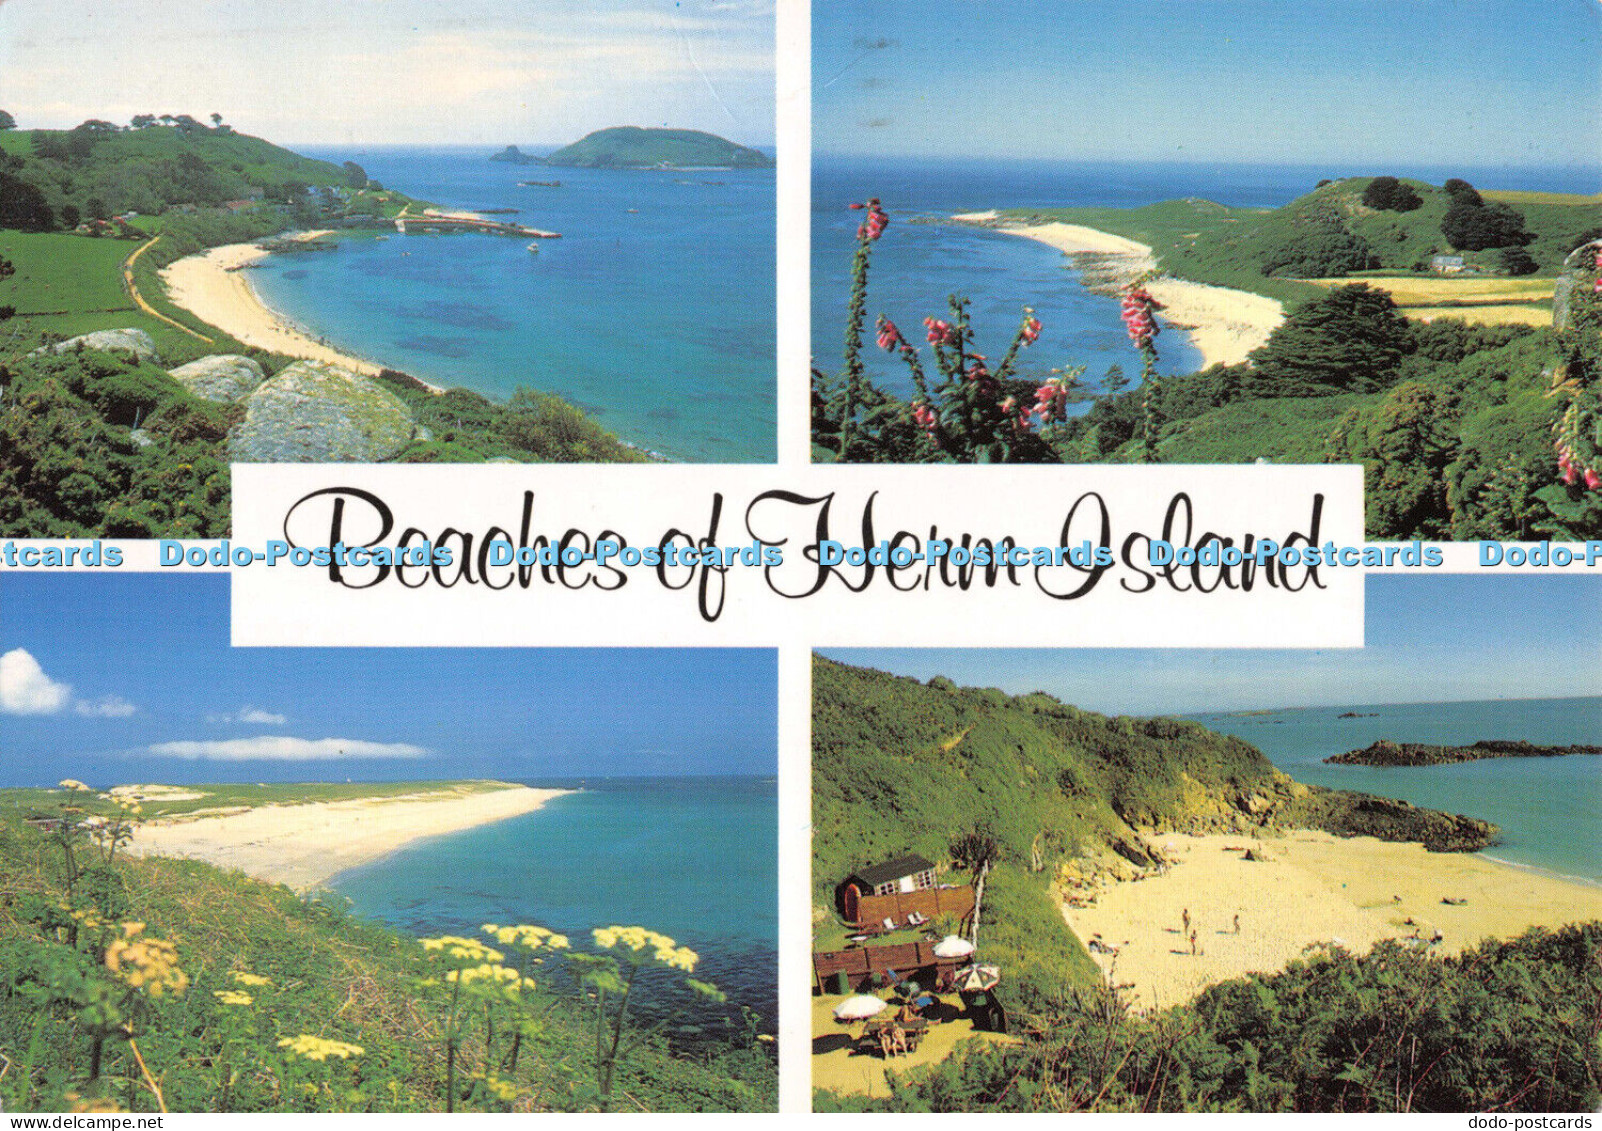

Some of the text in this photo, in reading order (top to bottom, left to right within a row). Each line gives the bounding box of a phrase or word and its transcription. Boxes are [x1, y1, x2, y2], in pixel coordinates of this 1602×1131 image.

[284, 487, 1327, 622] Beaches of Herm Island
